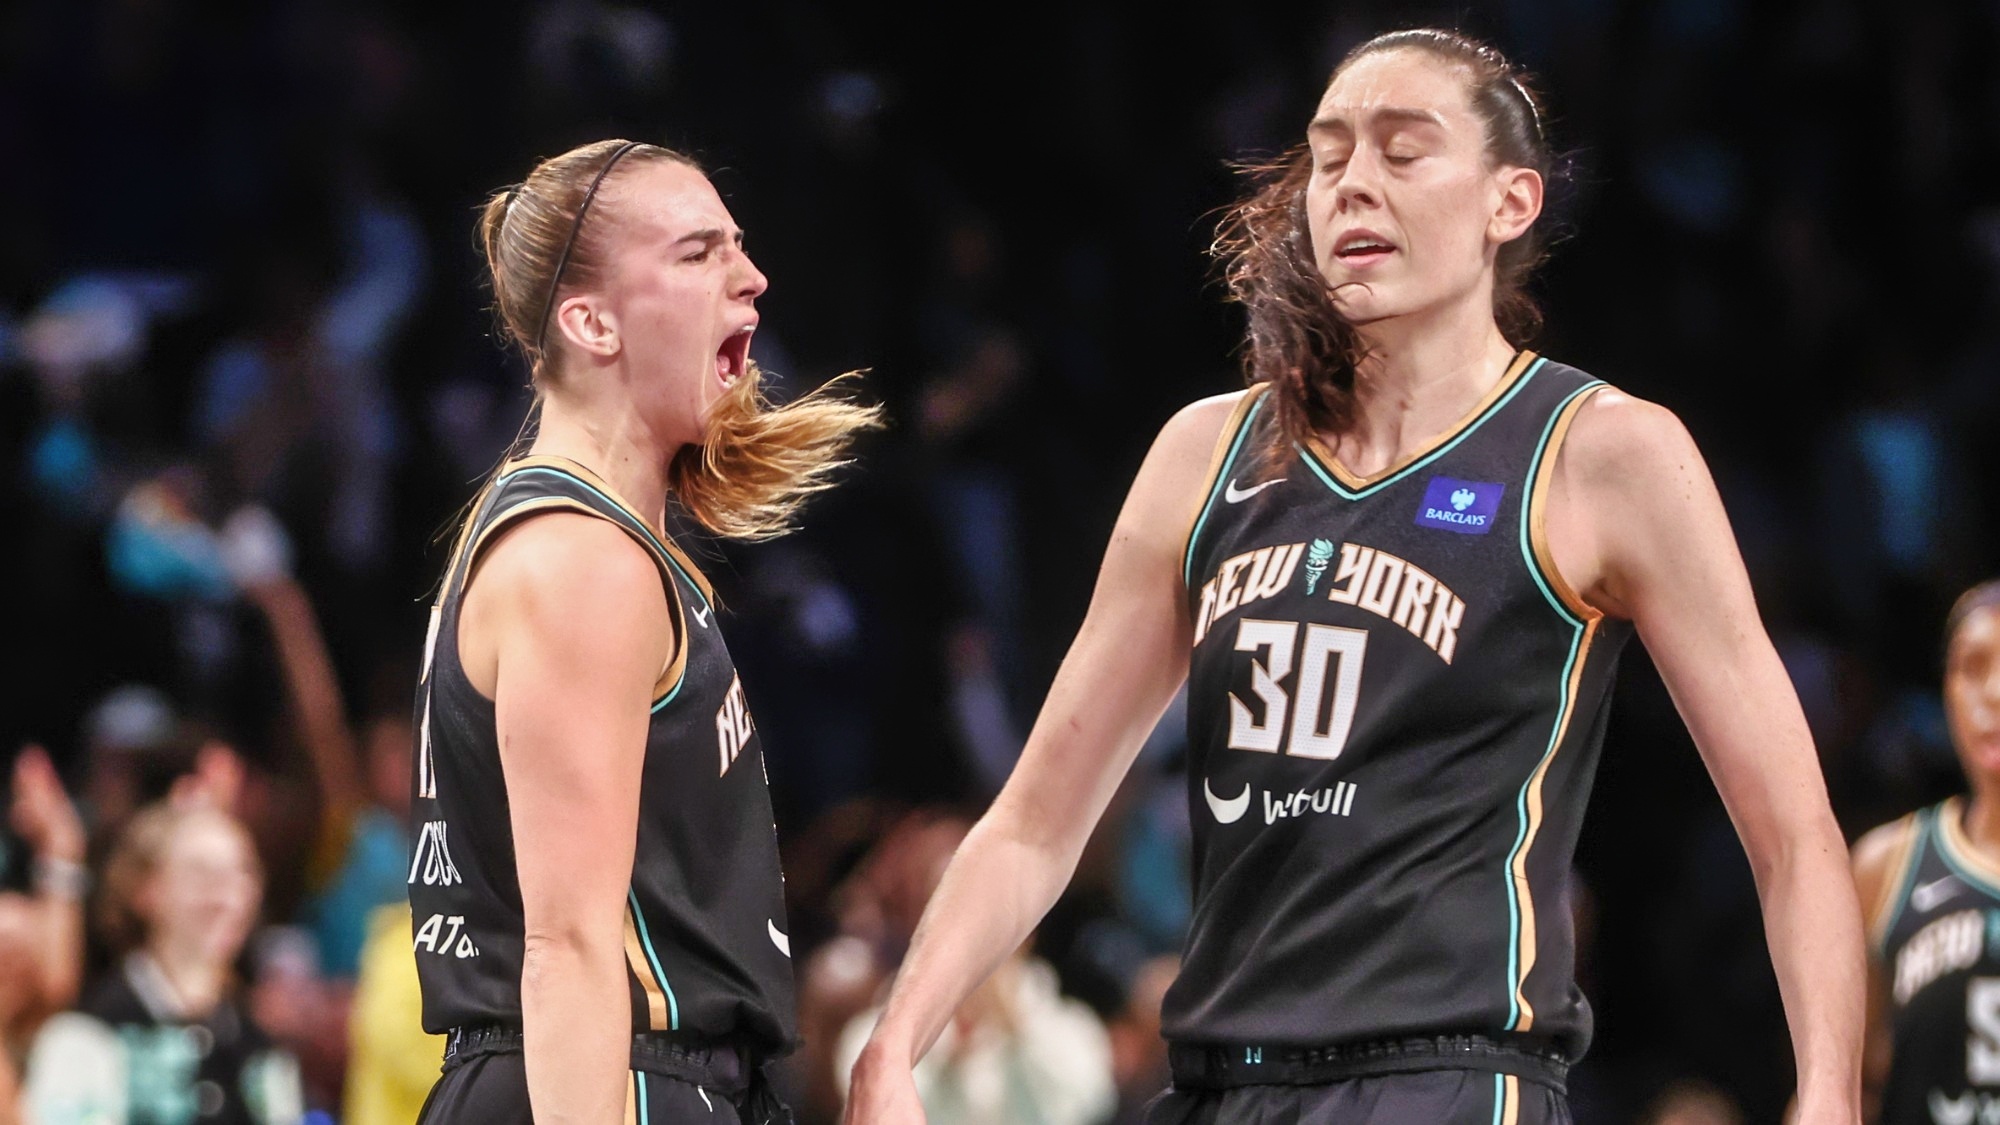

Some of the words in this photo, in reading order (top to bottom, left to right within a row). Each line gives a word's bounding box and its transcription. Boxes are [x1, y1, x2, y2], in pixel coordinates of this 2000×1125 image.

[1425, 507, 1487, 526] BARCLAYS
[1193, 542, 1306, 648] NEW
[1328, 542, 1466, 666] YORK
[716, 668, 756, 778] NE
[1228, 618, 1369, 760] 30
